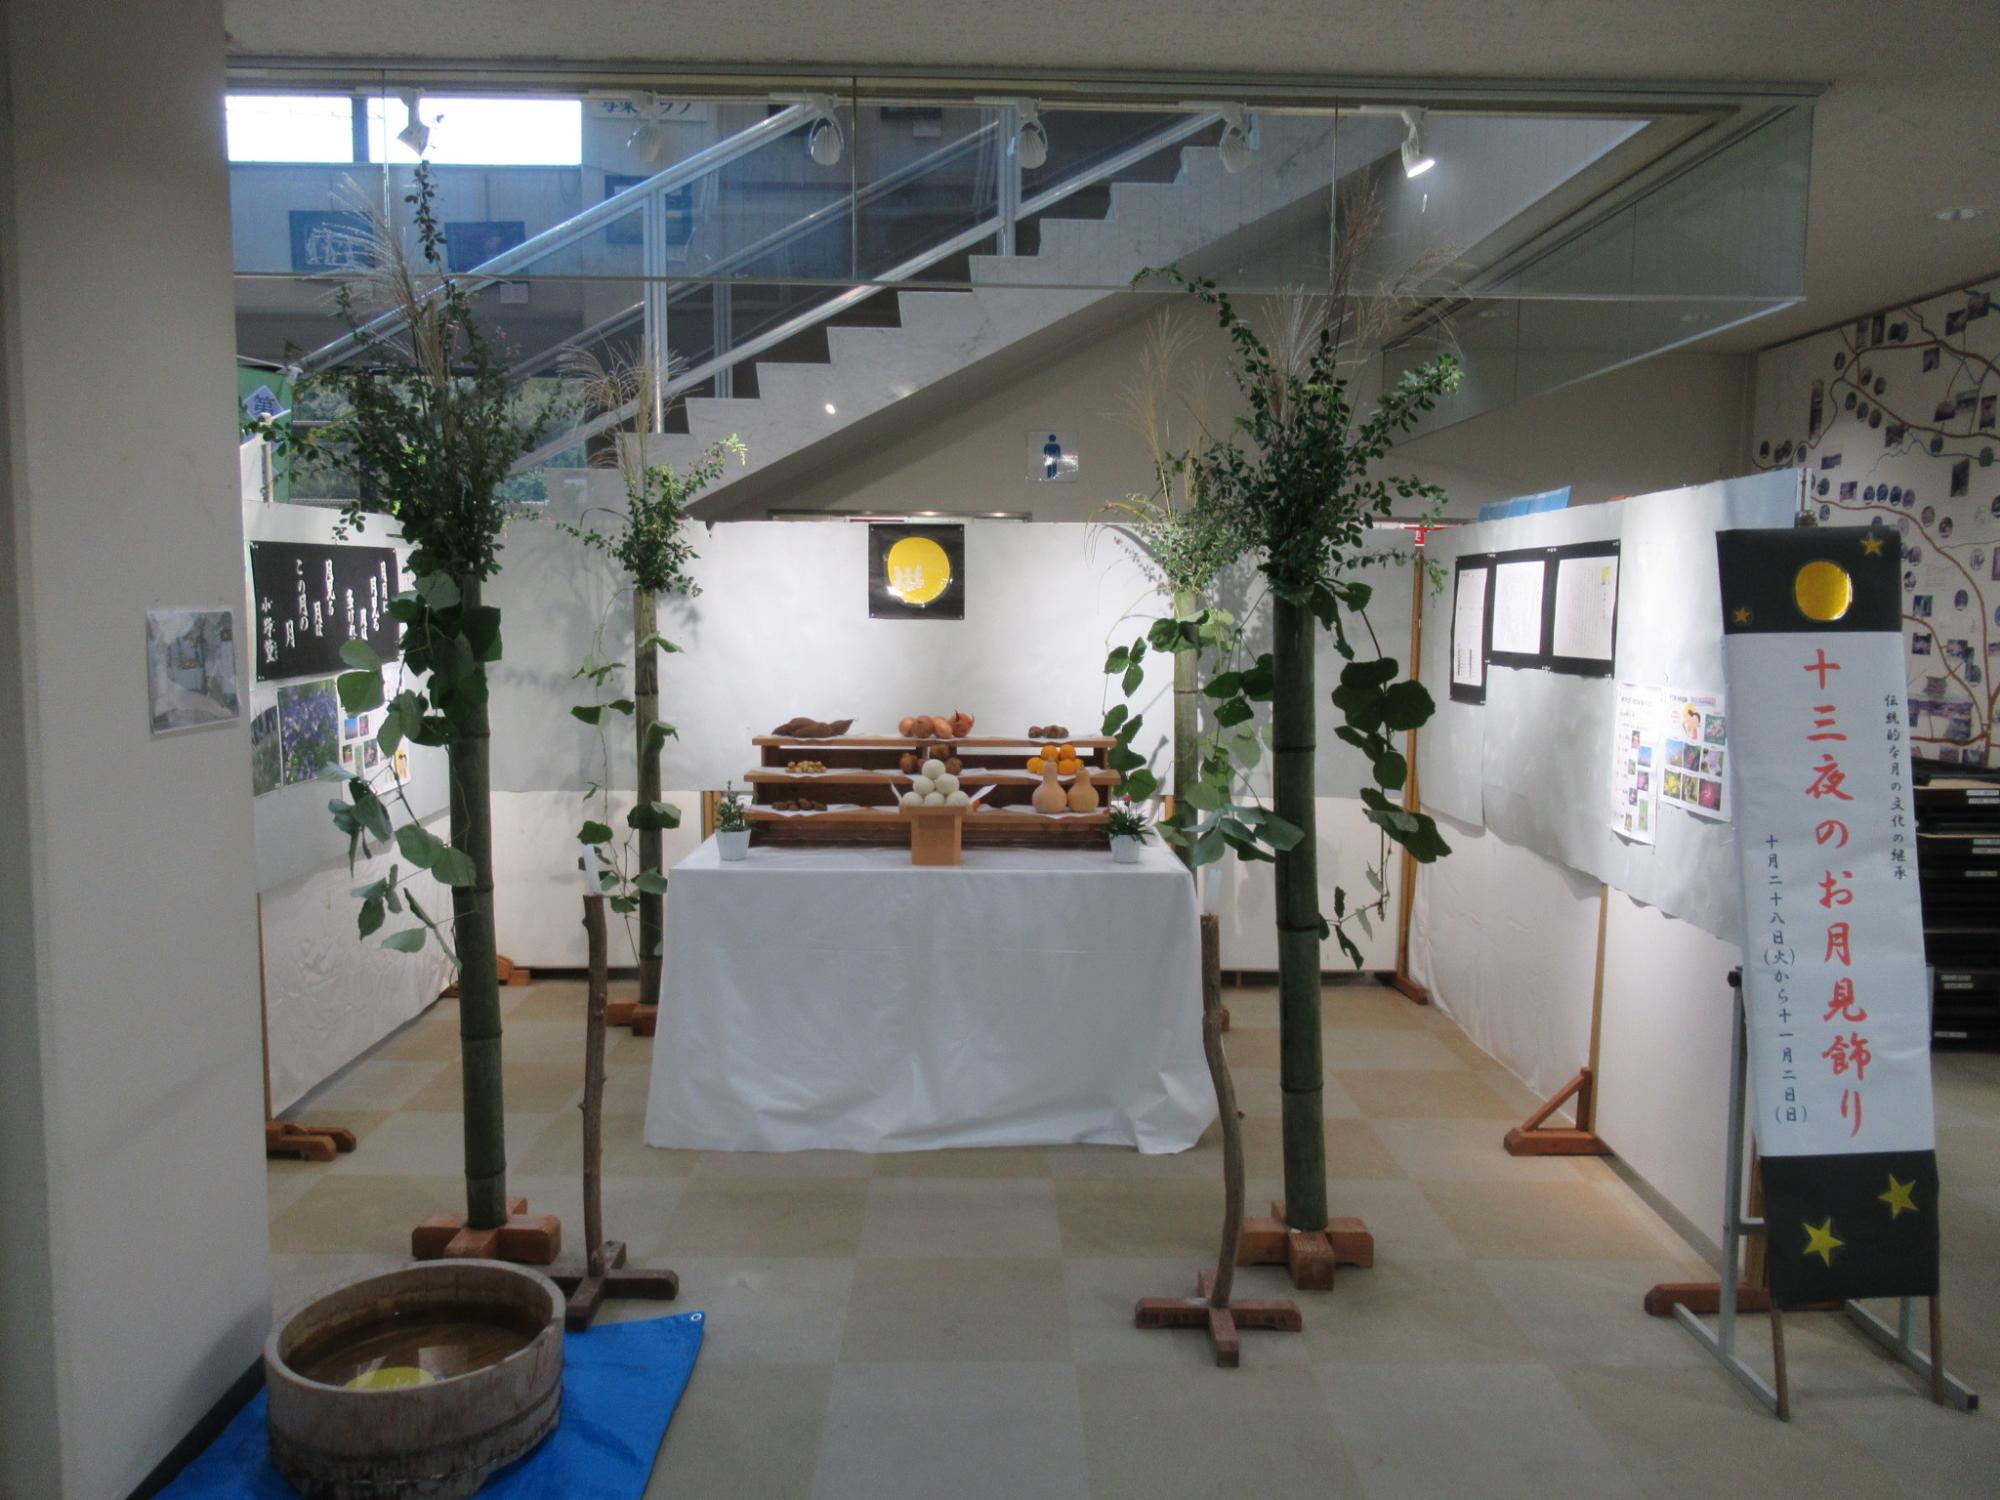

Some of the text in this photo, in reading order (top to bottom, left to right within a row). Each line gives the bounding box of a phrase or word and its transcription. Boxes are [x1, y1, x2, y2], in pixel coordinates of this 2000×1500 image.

[296, 558, 309, 632] この月の
[345, 588, 358, 640] 多けれ
[285, 619, 295, 649] 月
[1884, 693, 1908, 881] 伝統的な月の文化の継承
[1803, 647, 1872, 1138] 十三夜のお月見飾り
